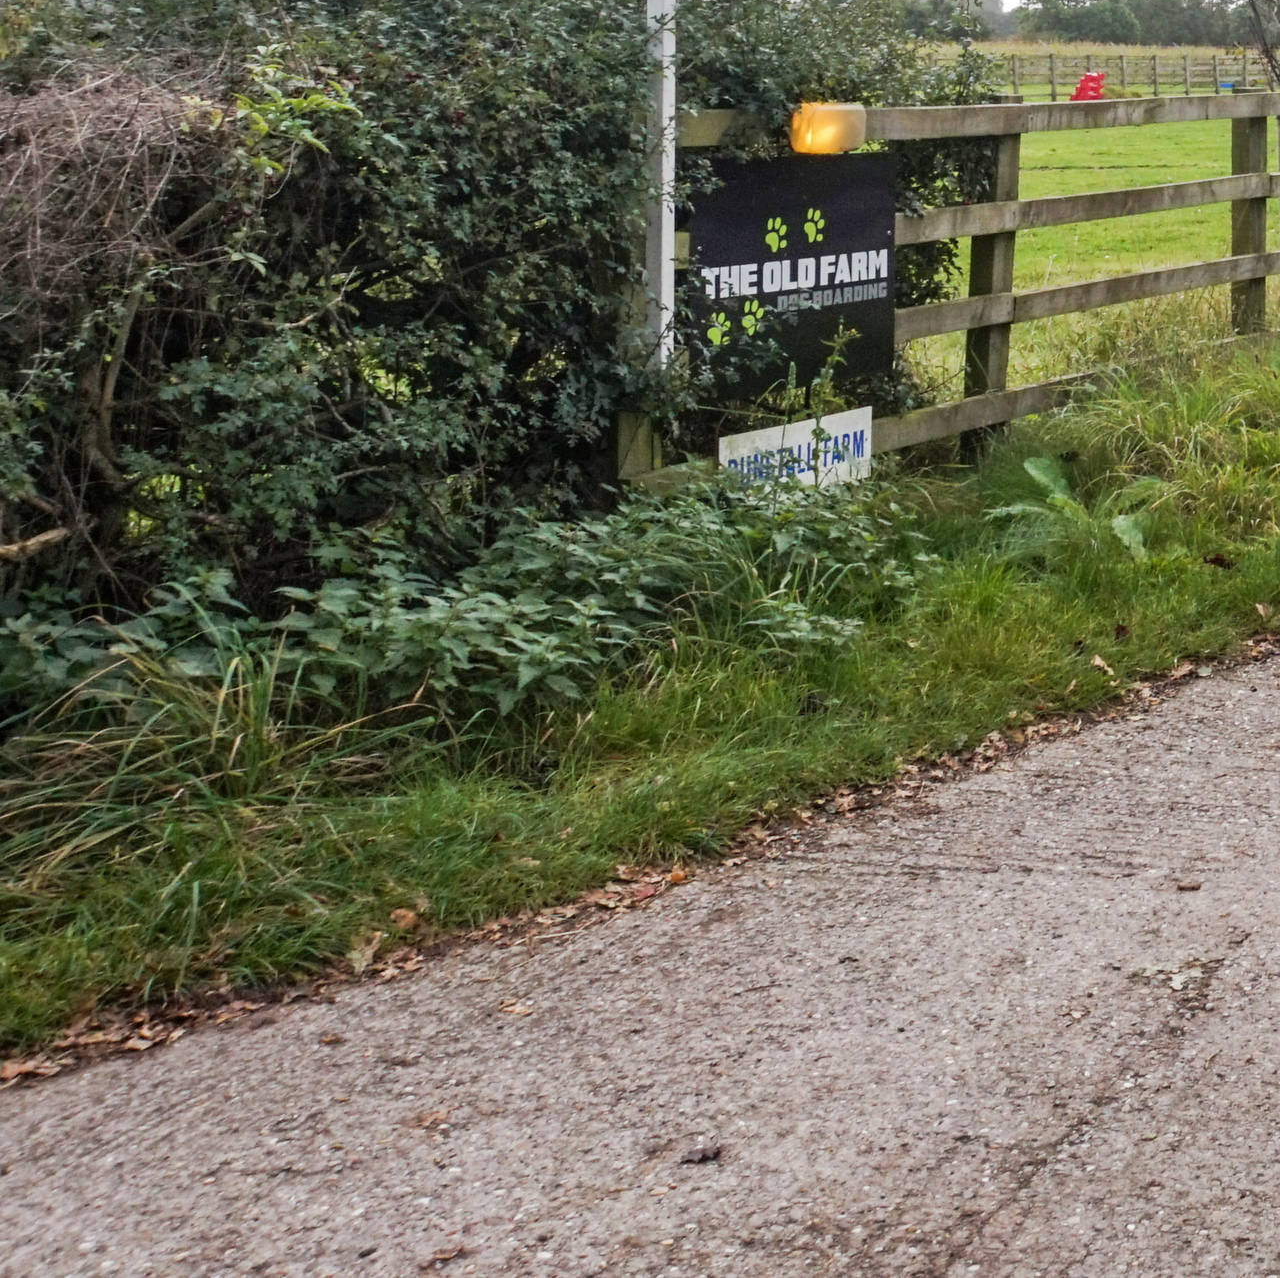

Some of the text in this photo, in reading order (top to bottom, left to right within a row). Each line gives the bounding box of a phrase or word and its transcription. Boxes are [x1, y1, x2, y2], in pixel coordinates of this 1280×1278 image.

[701, 248, 888, 300] THE OLD FARM
[813, 282, 888, 307] BOARDING
[822, 429, 865, 468] FARM
